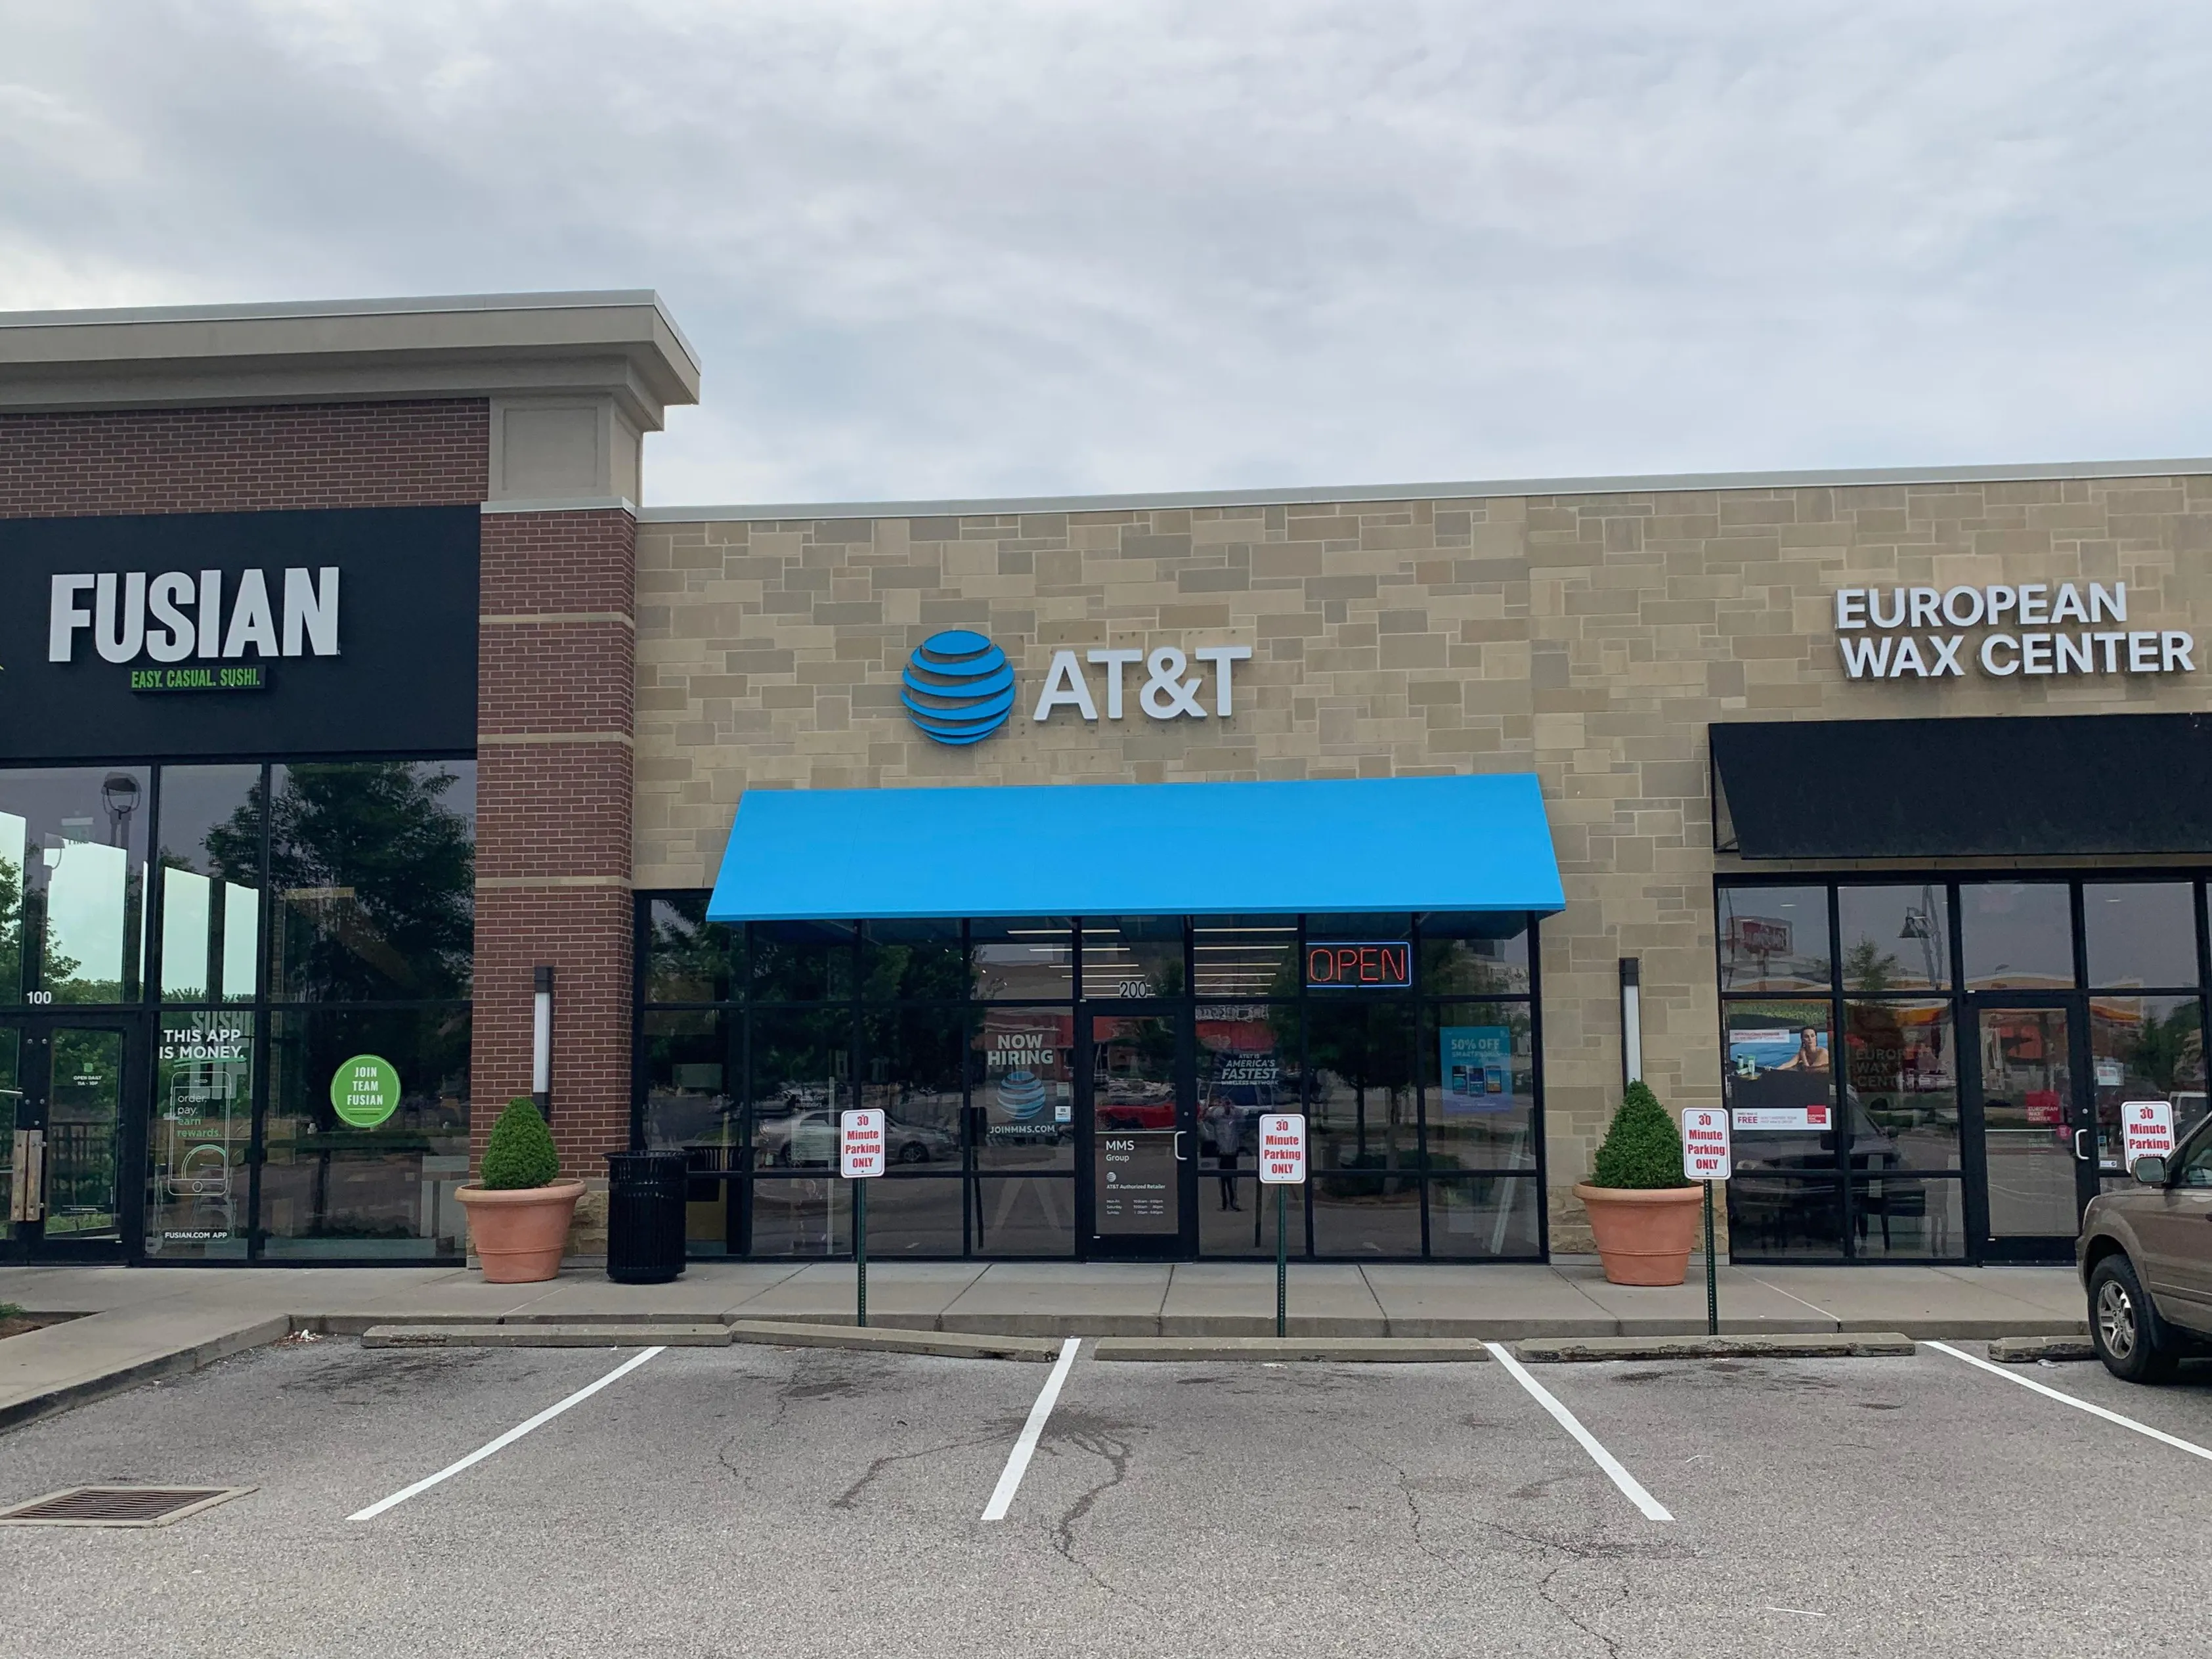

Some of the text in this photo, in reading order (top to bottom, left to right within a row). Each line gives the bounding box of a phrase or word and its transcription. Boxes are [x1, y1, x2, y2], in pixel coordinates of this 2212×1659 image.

[1836, 582, 2127, 629] EUROPEAN
[49, 567, 339, 663] FUSIAN
[1840, 631, 2196, 678] WAX CENTER
[132, 668, 260, 688] EASY. CASUAL. SUSHI.
[1033, 646, 1252, 721] AT&T
[1310, 948, 1404, 982] OPEN
[1121, 981, 1146, 998] 200
[27, 991, 51, 1004] 100
[163, 1029, 241, 1042] THIS APP
[998, 1034, 1042, 1049] NOW
[1451, 1038, 1500, 1050] 50% OFF
[159, 1046, 244, 1059] IS MONEY.
[987, 1050, 1053, 1065] HIRING
[355, 1067, 377, 1077] JOIN
[1221, 1068, 1280, 1079] FASTEST
[353, 1081, 379, 1091] TEAM
[347, 1095, 383, 1105] FUSIAN
[177, 1107, 198, 1116] pay.
[2140, 1109, 2153, 1119] 30
[857, 1116, 869, 1126] 30
[1699, 1115, 1711, 1125] 30
[989, 1125, 1055, 1134] JOINMMS.COM
[1276, 1121, 1288, 1131] 30
[2130, 1124, 2166, 1134] Minute
[177, 1128, 222, 1138] rewards.
[847, 1130, 878, 1140] Minute
[1689, 1130, 1722, 1139] Minute
[1106, 1140, 1135, 1151] MMS
[1266, 1136, 1299, 1145] Minute
[2129, 1139, 2169, 1150] Parking
[845, 1144, 880, 1155] Parking
[1264, 1149, 1301, 1161] Parking
[1688, 1144, 1725, 1156] Parking
[853, 1158, 873, 1168] ONLY
[1106, 1154, 1129, 1162] Group
[1272, 1164, 1293, 1174] ONLY
[1696, 1159, 1718, 1169] ONLY
